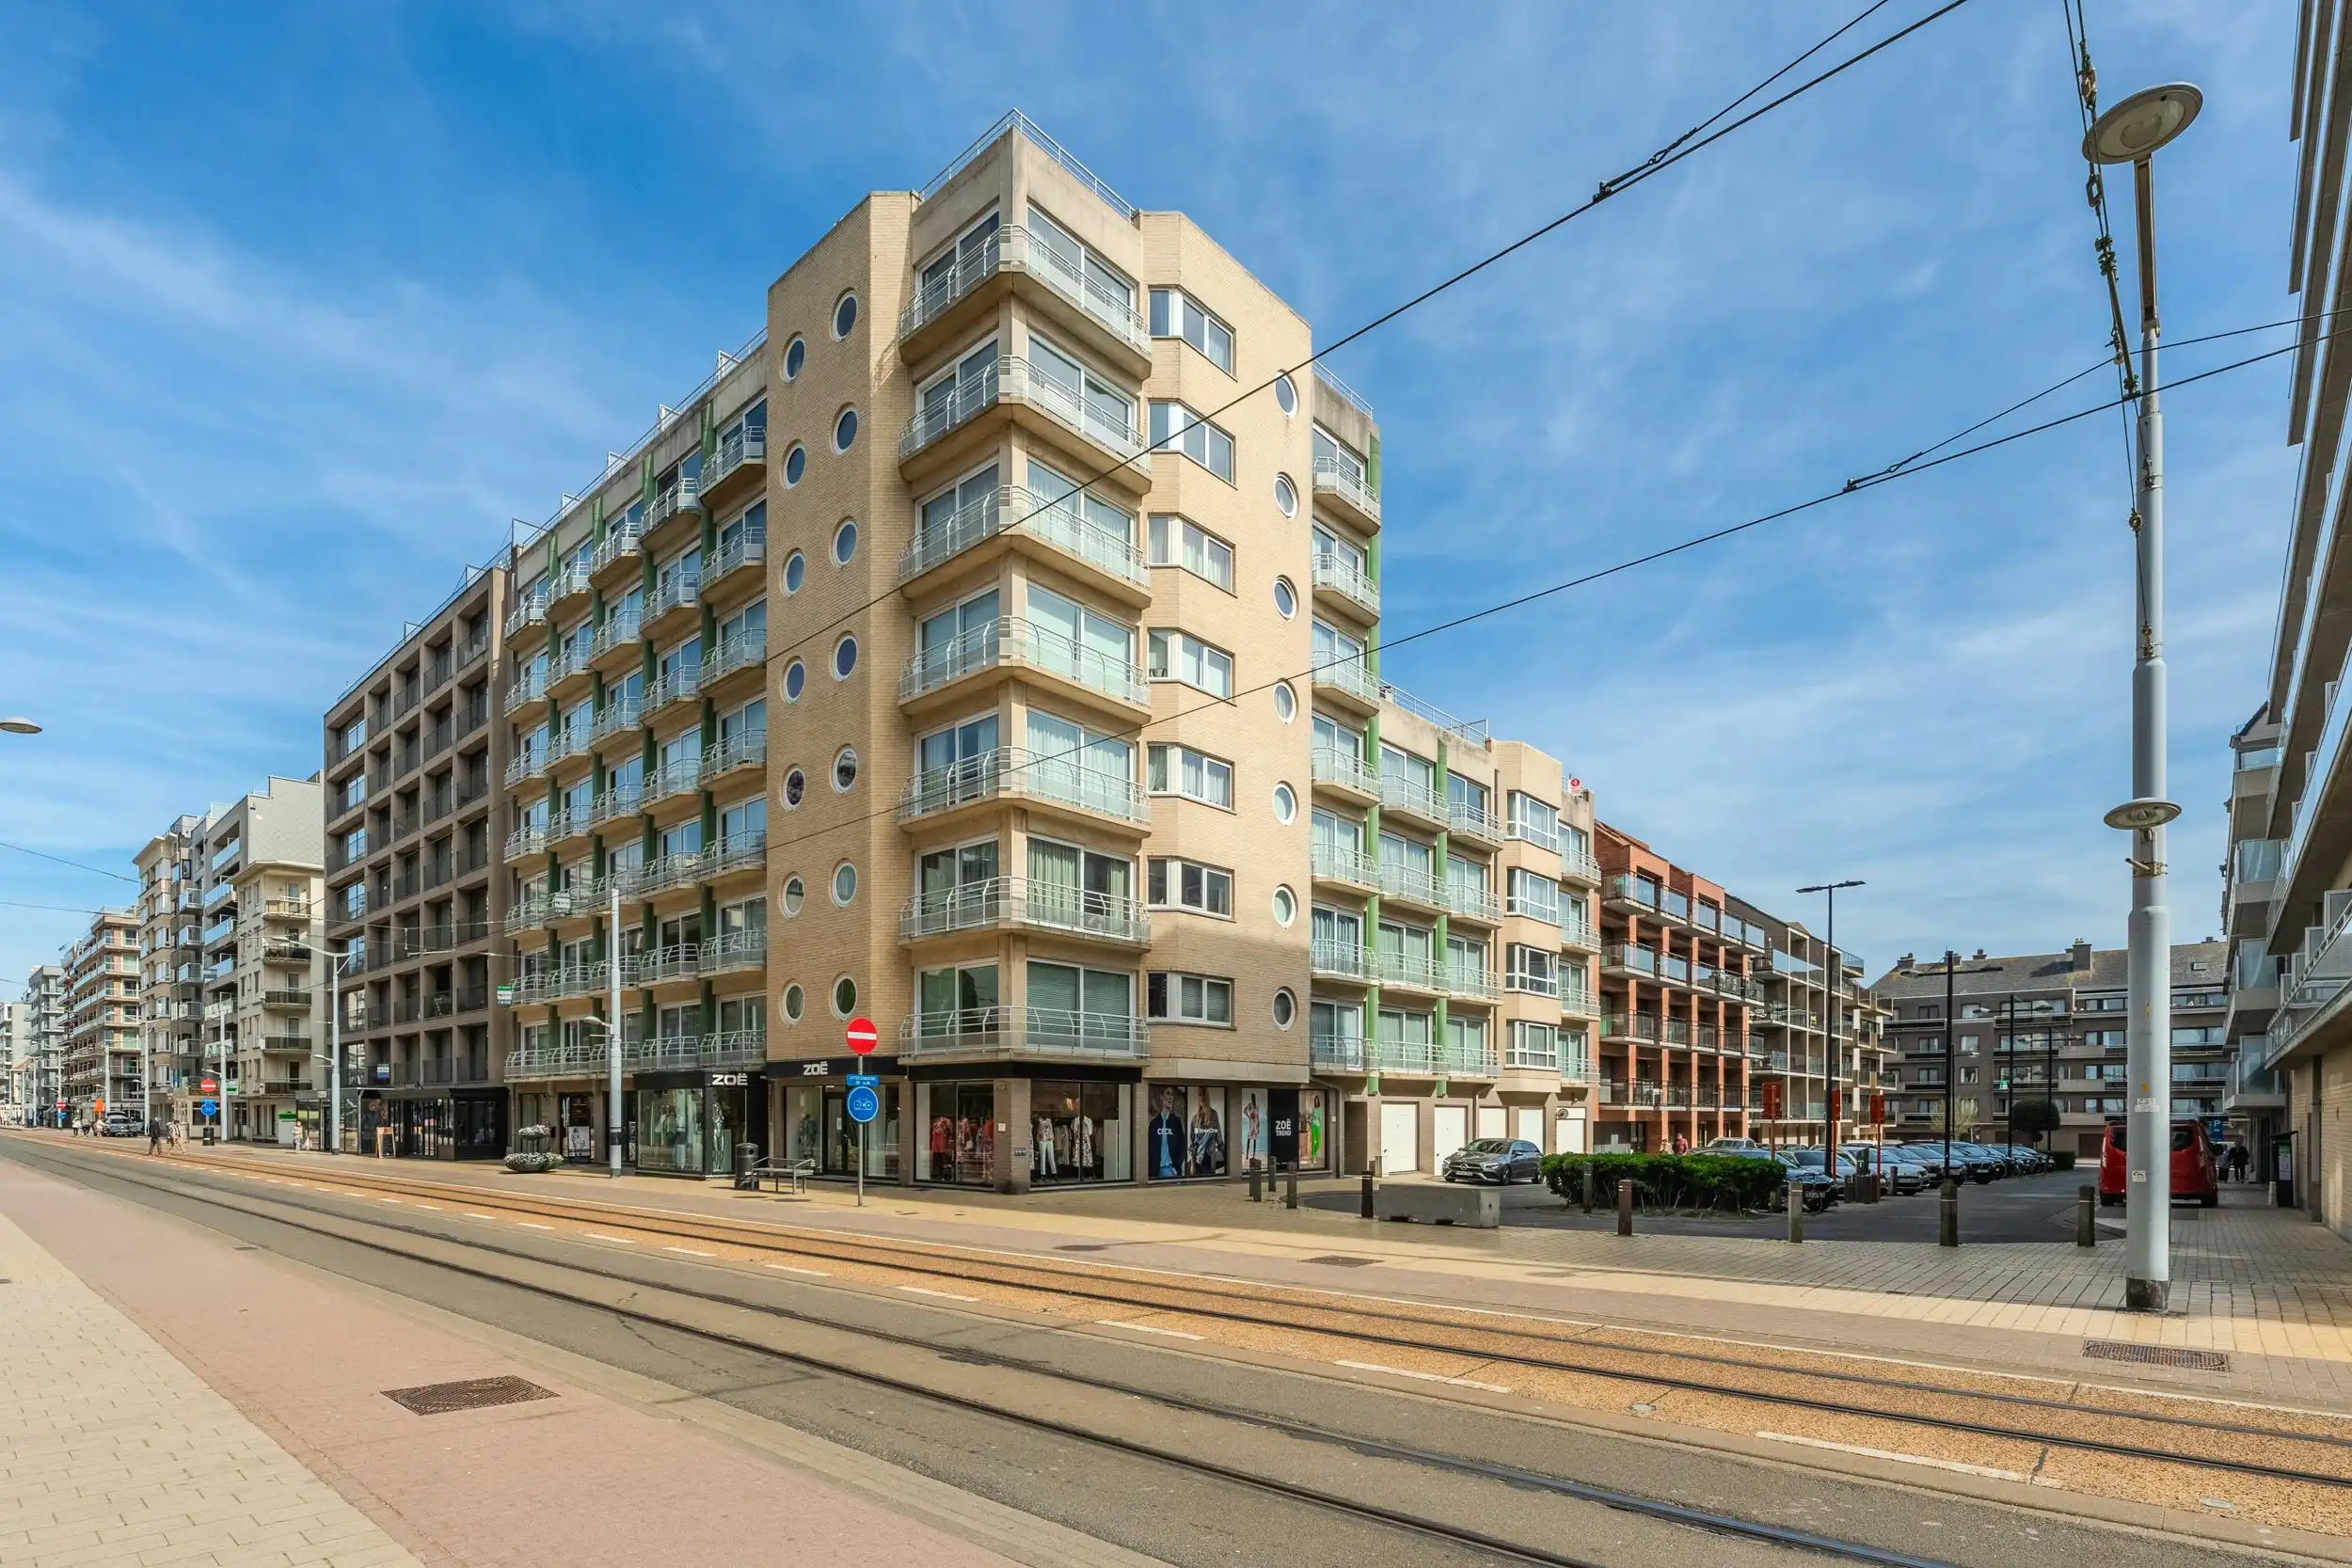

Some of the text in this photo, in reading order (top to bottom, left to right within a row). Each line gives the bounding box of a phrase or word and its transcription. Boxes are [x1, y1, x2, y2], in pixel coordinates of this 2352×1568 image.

[803, 1061, 828, 1076] ZOË
[712, 1073, 748, 1086] ZOË
[1275, 1118, 1292, 1130] ZOË
